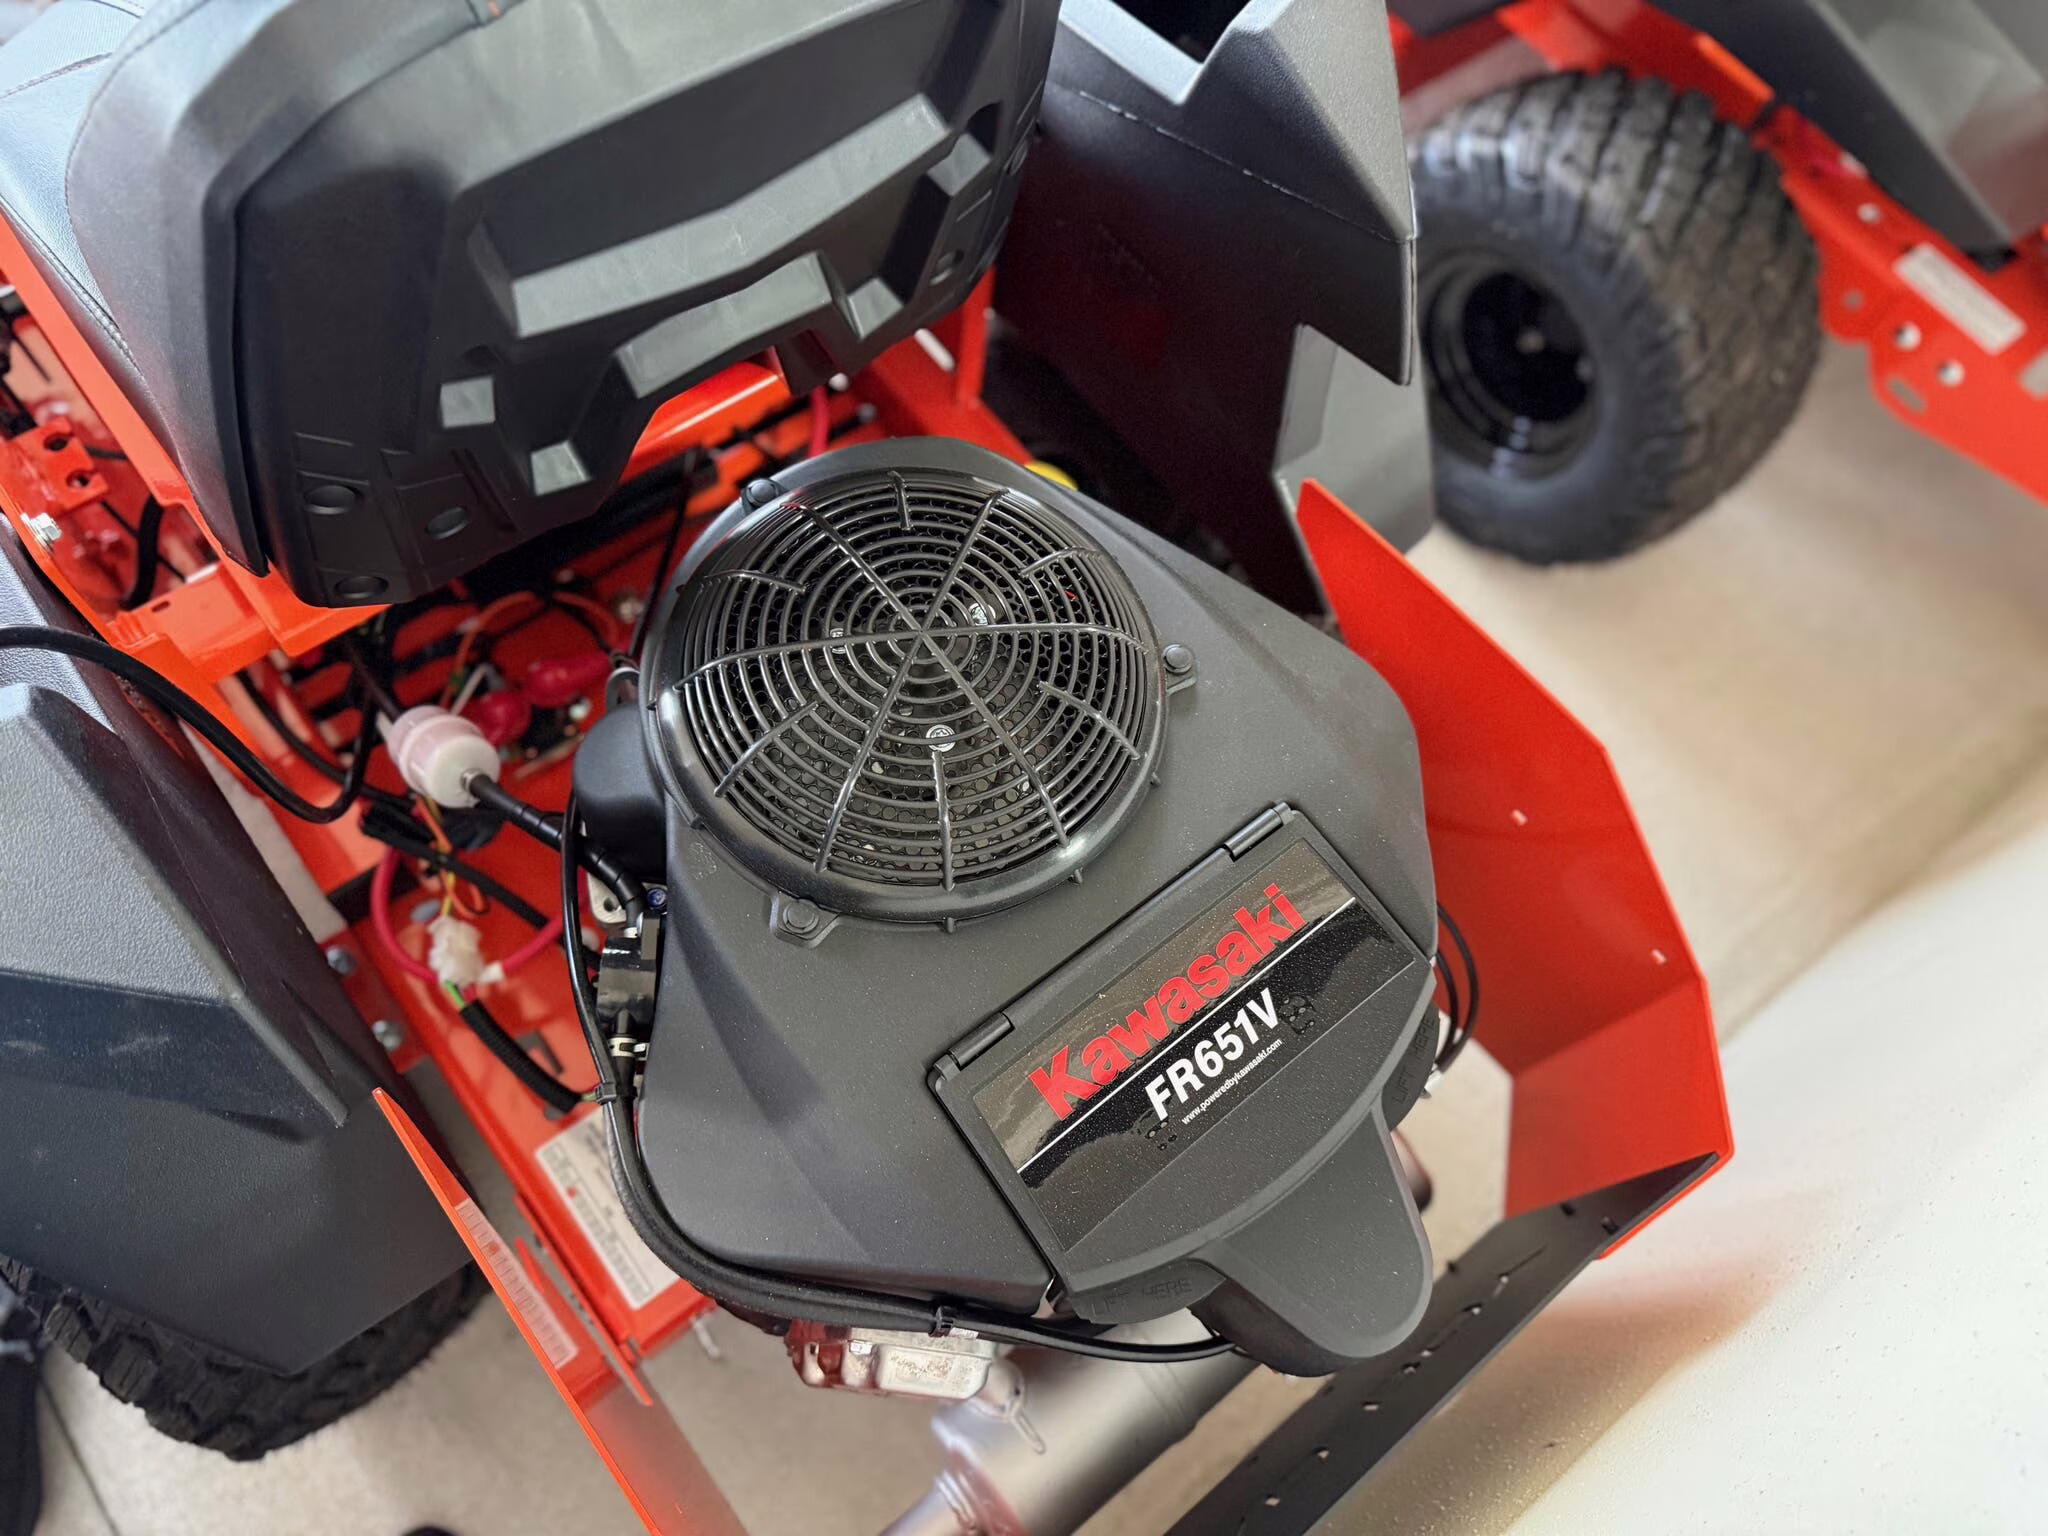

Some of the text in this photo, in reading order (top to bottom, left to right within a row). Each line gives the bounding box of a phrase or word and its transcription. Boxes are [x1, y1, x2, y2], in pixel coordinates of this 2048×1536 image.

[1028, 883, 1306, 1121] Kawasaki
[1145, 988, 1279, 1121] FR651V
[1181, 1038, 1283, 1126] www.poweredbykawasaki.com
